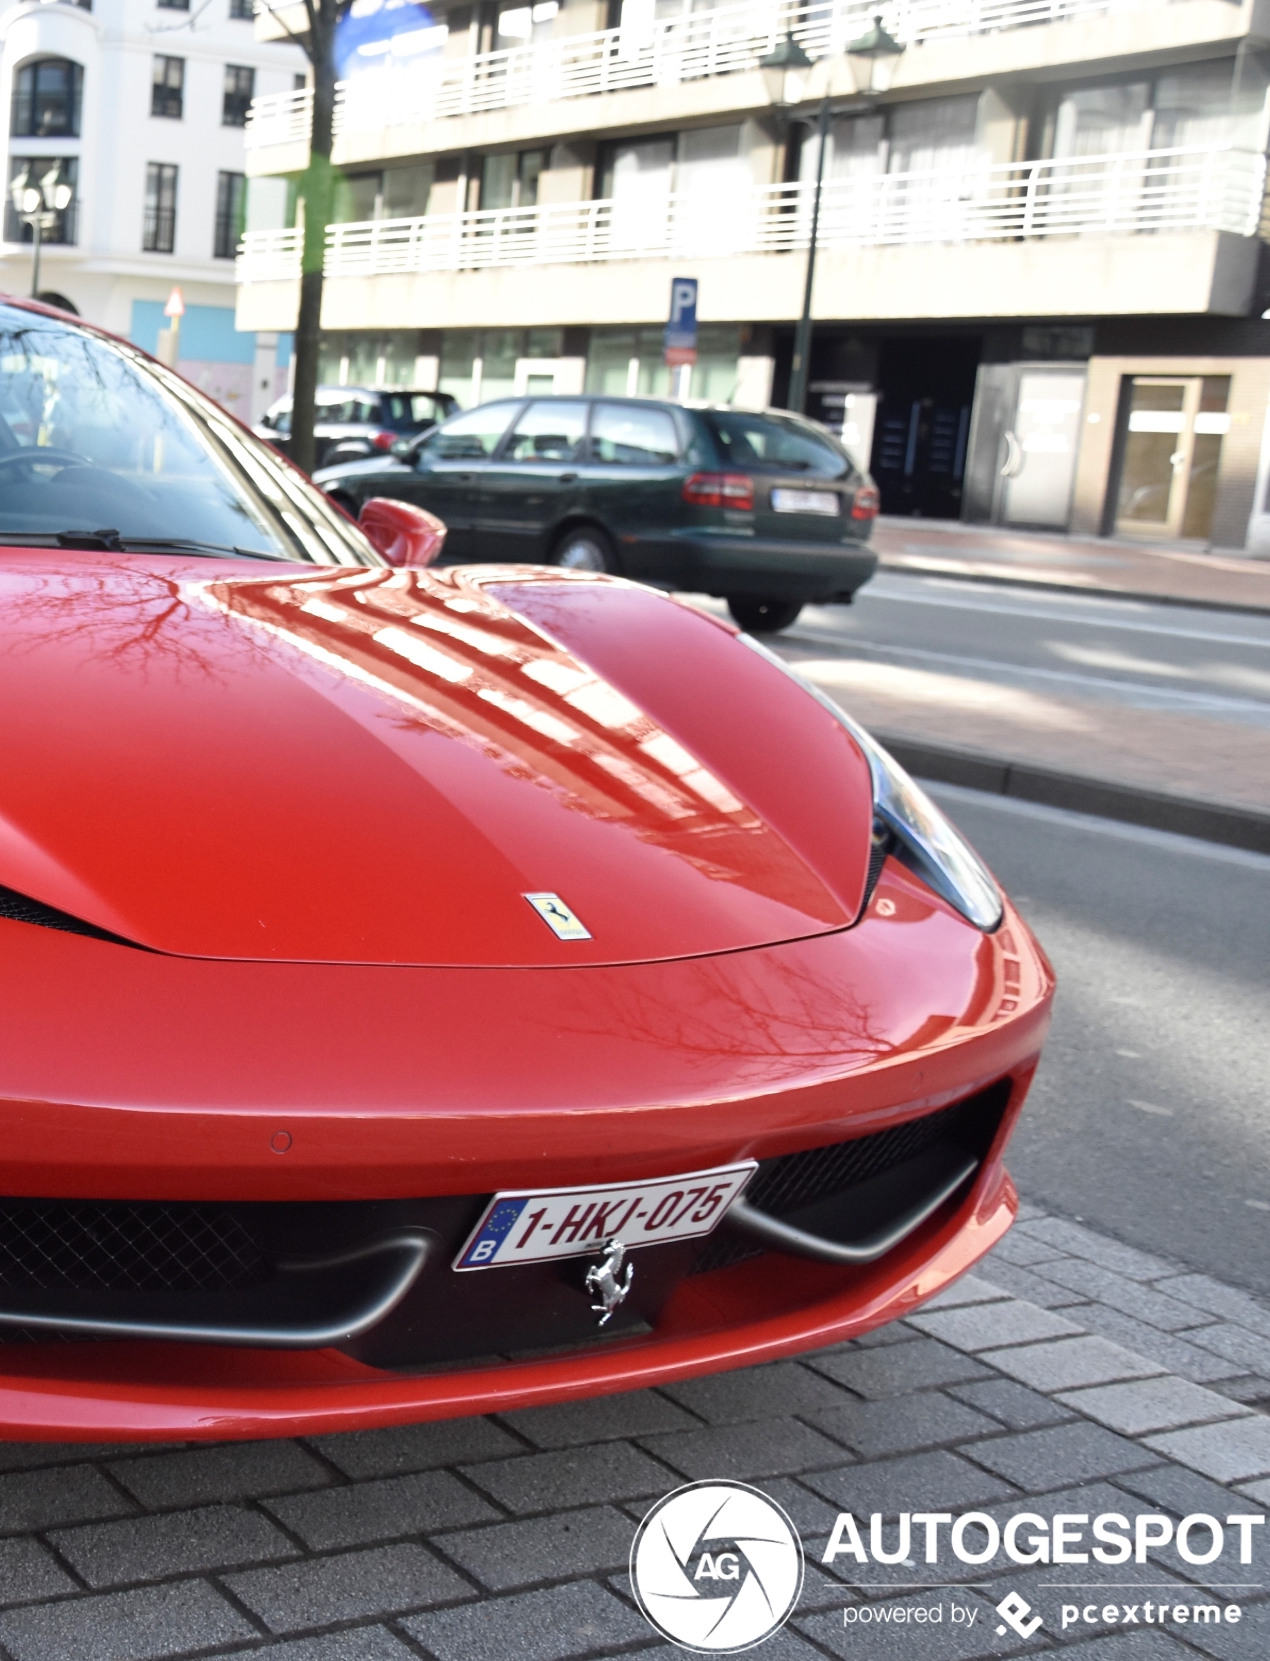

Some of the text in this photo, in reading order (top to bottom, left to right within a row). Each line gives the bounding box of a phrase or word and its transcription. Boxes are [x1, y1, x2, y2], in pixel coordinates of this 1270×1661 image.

[672, 283, 696, 322] P
[515, 1182, 733, 1249] 1-HKJ-075
[470, 1240, 497, 1262] B
